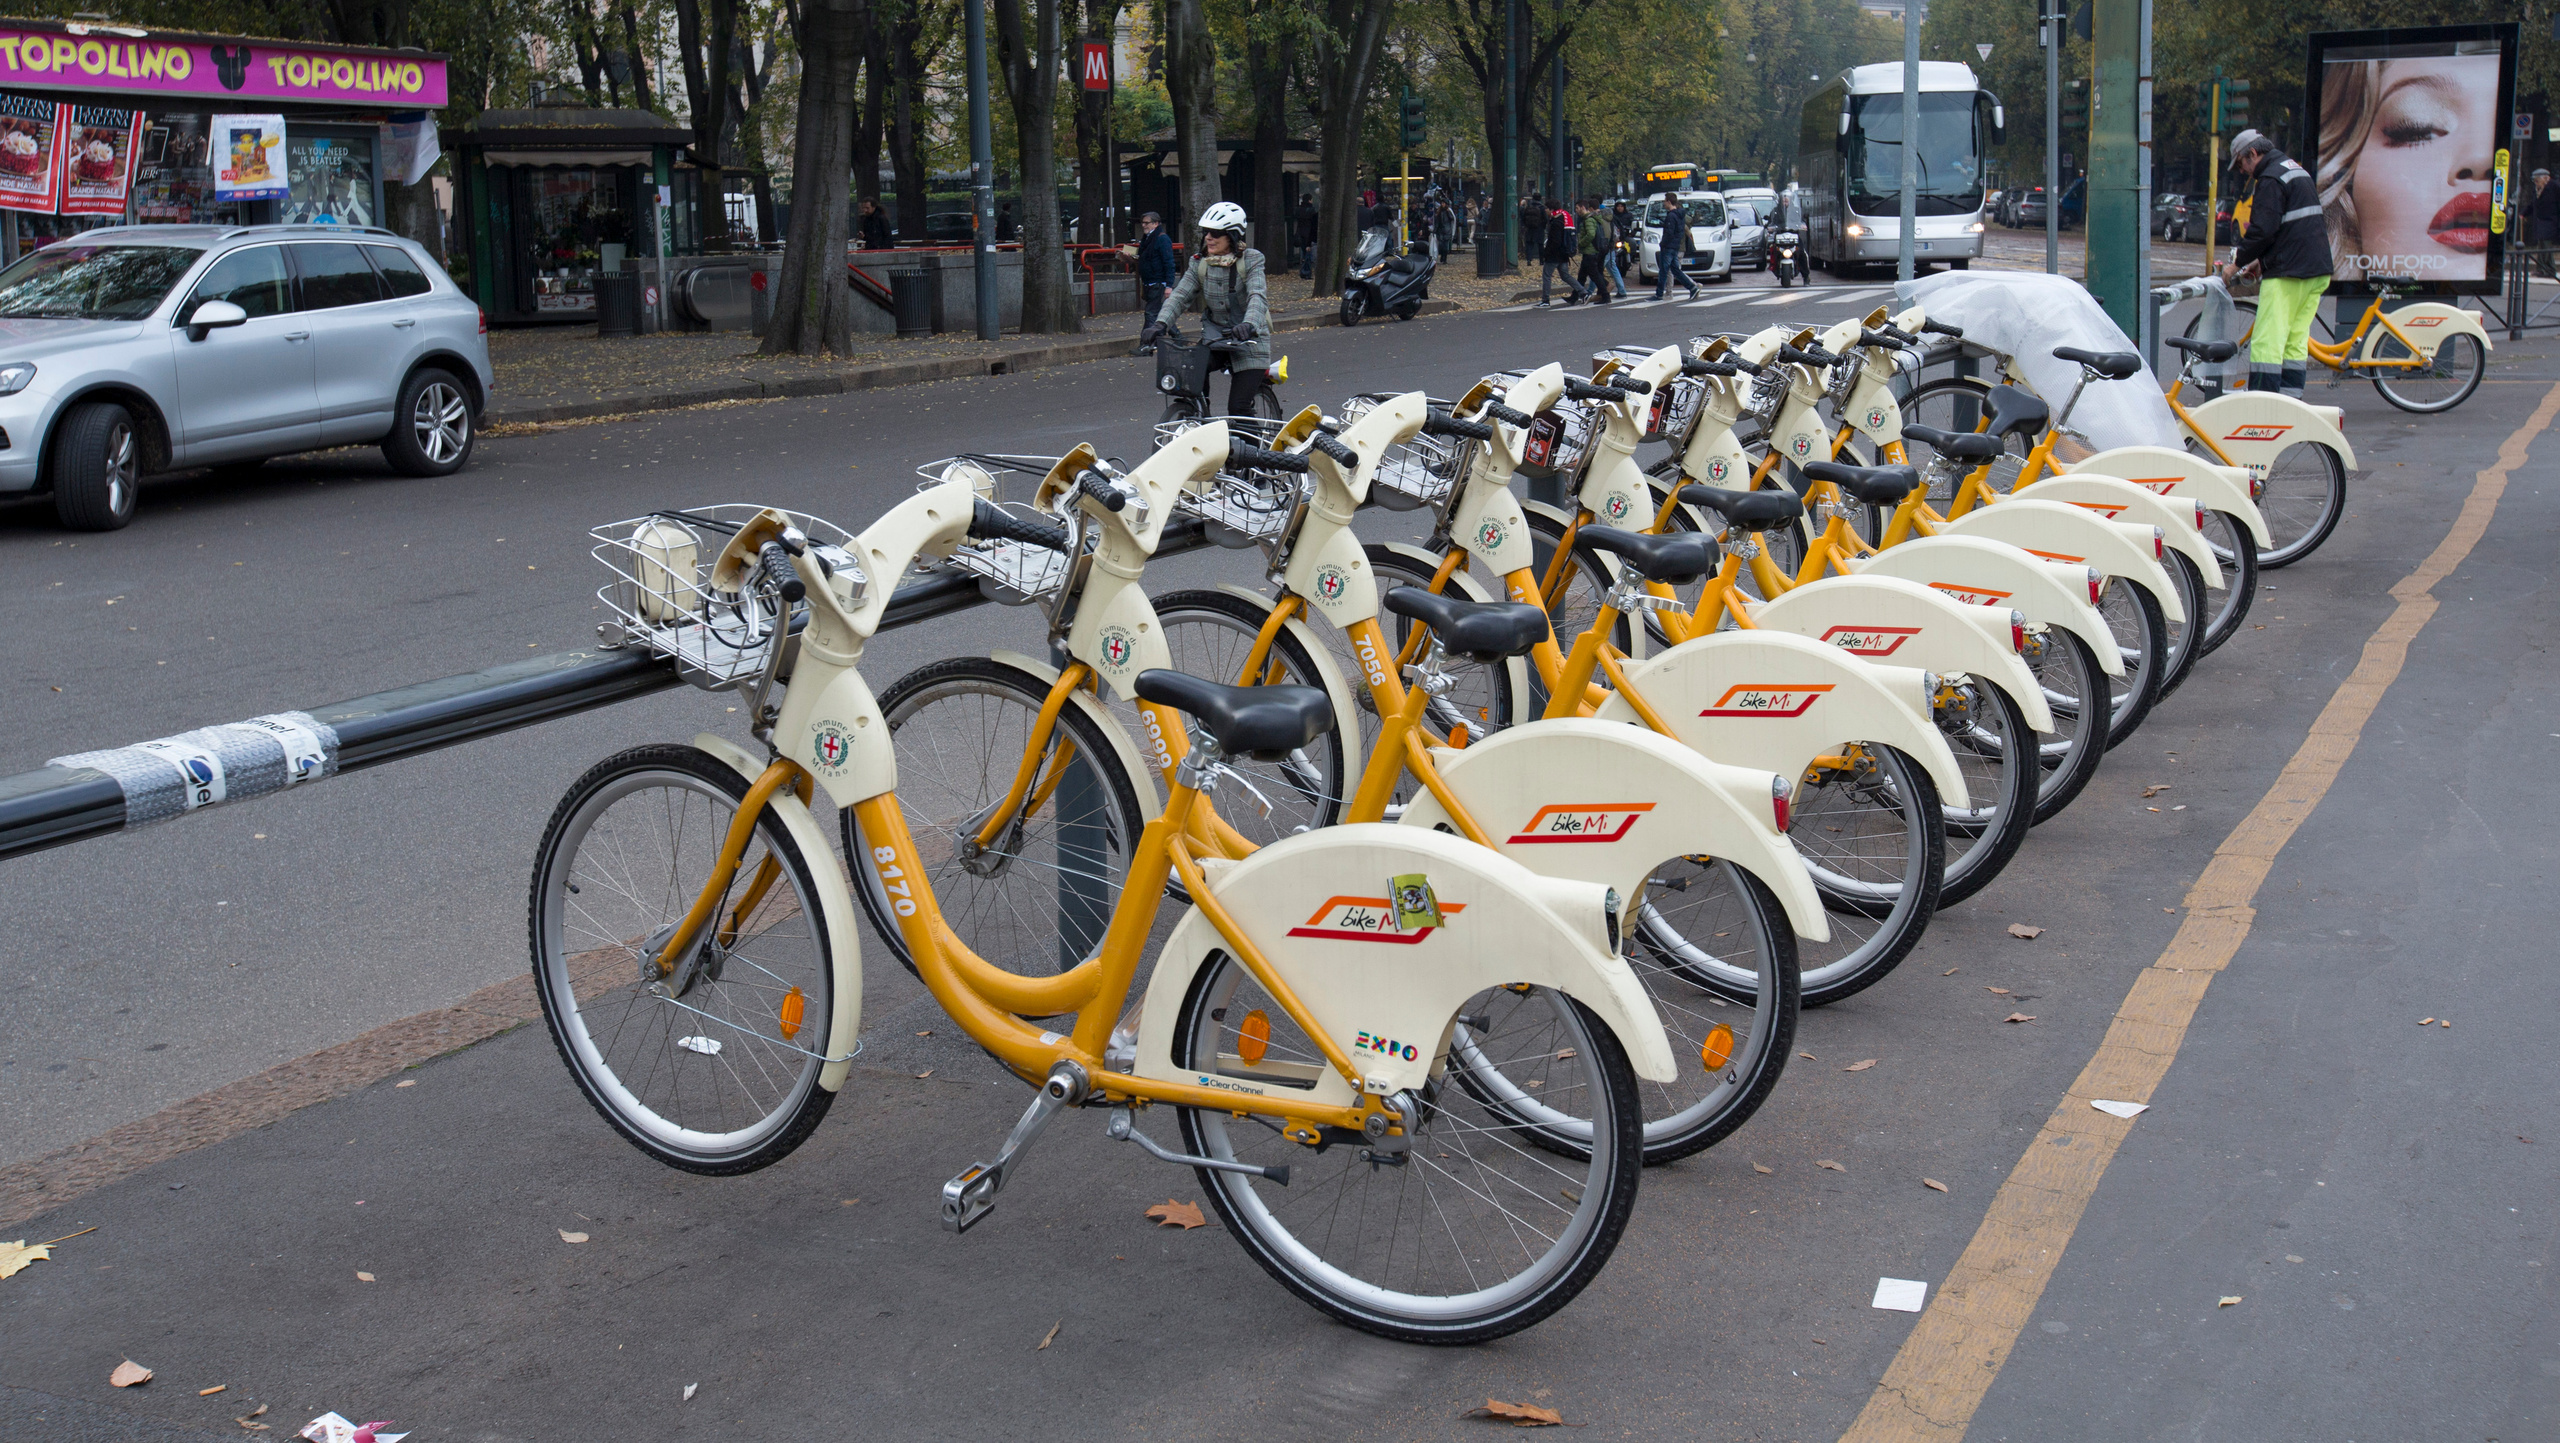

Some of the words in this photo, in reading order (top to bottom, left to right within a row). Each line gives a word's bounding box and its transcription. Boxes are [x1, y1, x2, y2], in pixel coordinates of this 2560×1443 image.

[0, 36, 194, 81] TOPOLINO
[1085, 51, 1107, 80] M
[267, 55, 425, 93] TOPOLINO
[2, 103, 51, 120] TALIANA
[13, 95, 52, 111] CUCINA
[78, 113, 128, 127] ITALIANA
[93, 107, 129, 119] CUCINA
[292, 146, 306, 156] ALL
[308, 146, 325, 156] YOU
[327, 147, 349, 157] NEED
[310, 156, 342, 165] BEATLES
[2345, 254, 2388, 270] TOM
[2392, 254, 2448, 270] FORD
[1608, 490, 1631, 502] Comune
[1482, 516, 1507, 531] Comune
[1602, 508, 1624, 525] Milano
[1473, 536, 1497, 556] Milano
[1316, 563, 1346, 574] Comune
[1313, 590, 1343, 607] Milano
[1100, 624, 1131, 637] Comune
[1837, 632, 1884, 649] bikeMi
[1099, 658, 1131, 675] Milano
[1355, 633, 1386, 687] 7056
[1739, 691, 1792, 709] bikeMi
[811, 718, 848, 733] Comune
[1141, 709, 1172, 769] 6999
[810, 756, 849, 778] Milano
[1551, 813, 1609, 834] bikeMi
[874, 845, 917, 917] 8170
[1340, 906, 1399, 933] bikeM
[1355, 1030, 1418, 1062] EXPO
[1353, 1050, 1375, 1061] MILANO
[1210, 1078, 1230, 1090] Clear
[1231, 1081, 1264, 1096] Channel
